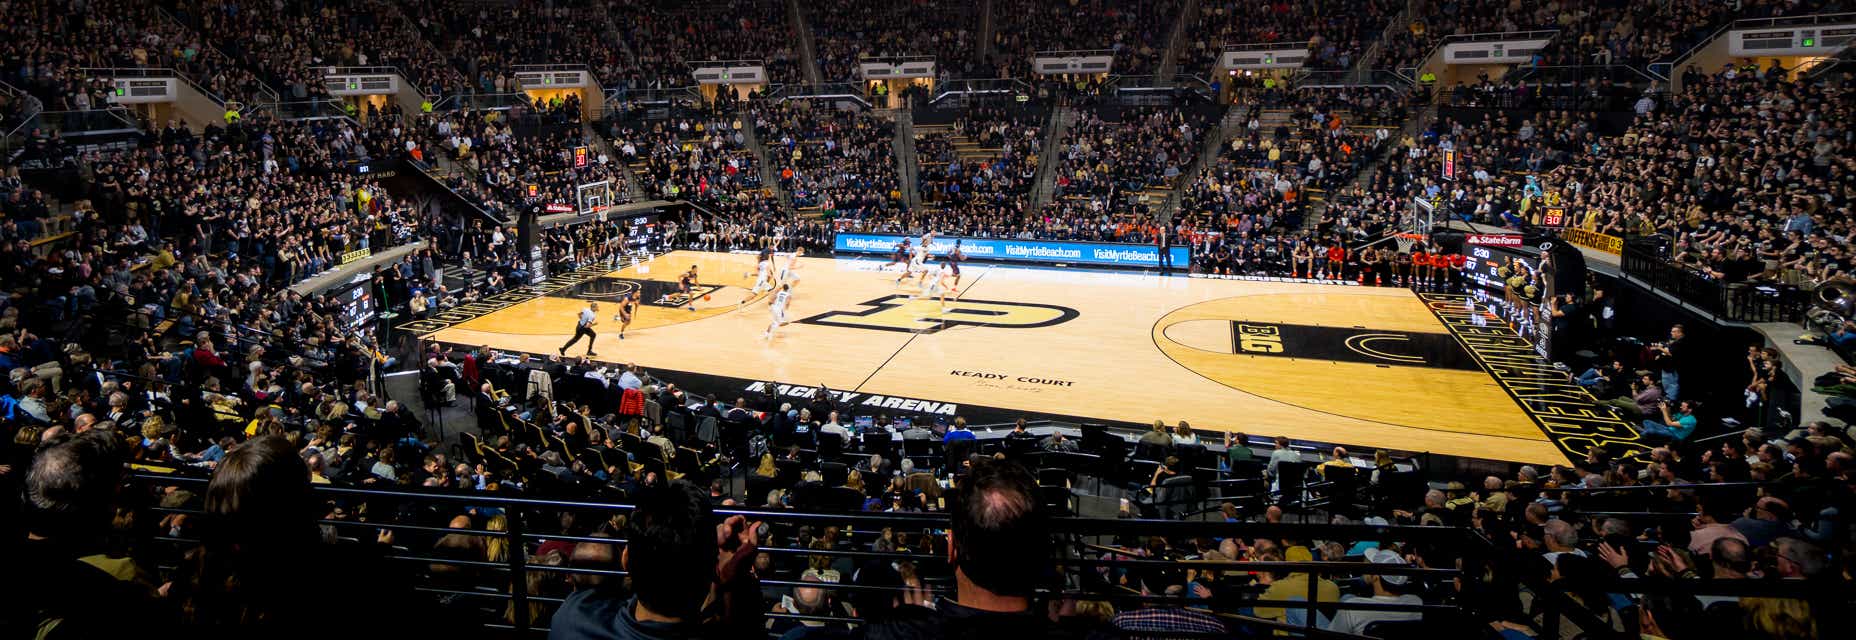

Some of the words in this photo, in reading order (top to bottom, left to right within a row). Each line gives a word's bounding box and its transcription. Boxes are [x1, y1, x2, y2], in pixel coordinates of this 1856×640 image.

[576, 155, 585, 166] 30
[1546, 216, 1560, 225] 30
[1568, 228, 1599, 249] DEFENSE
[1005, 244, 1081, 258] VisitMyrtleBeach.com
[1093, 248, 1175, 263] VisitMyrtleBeach.om
[950, 369, 1009, 380] KEADY
[1016, 376, 1077, 387] COURT
[862, 394, 958, 415] ARENA
